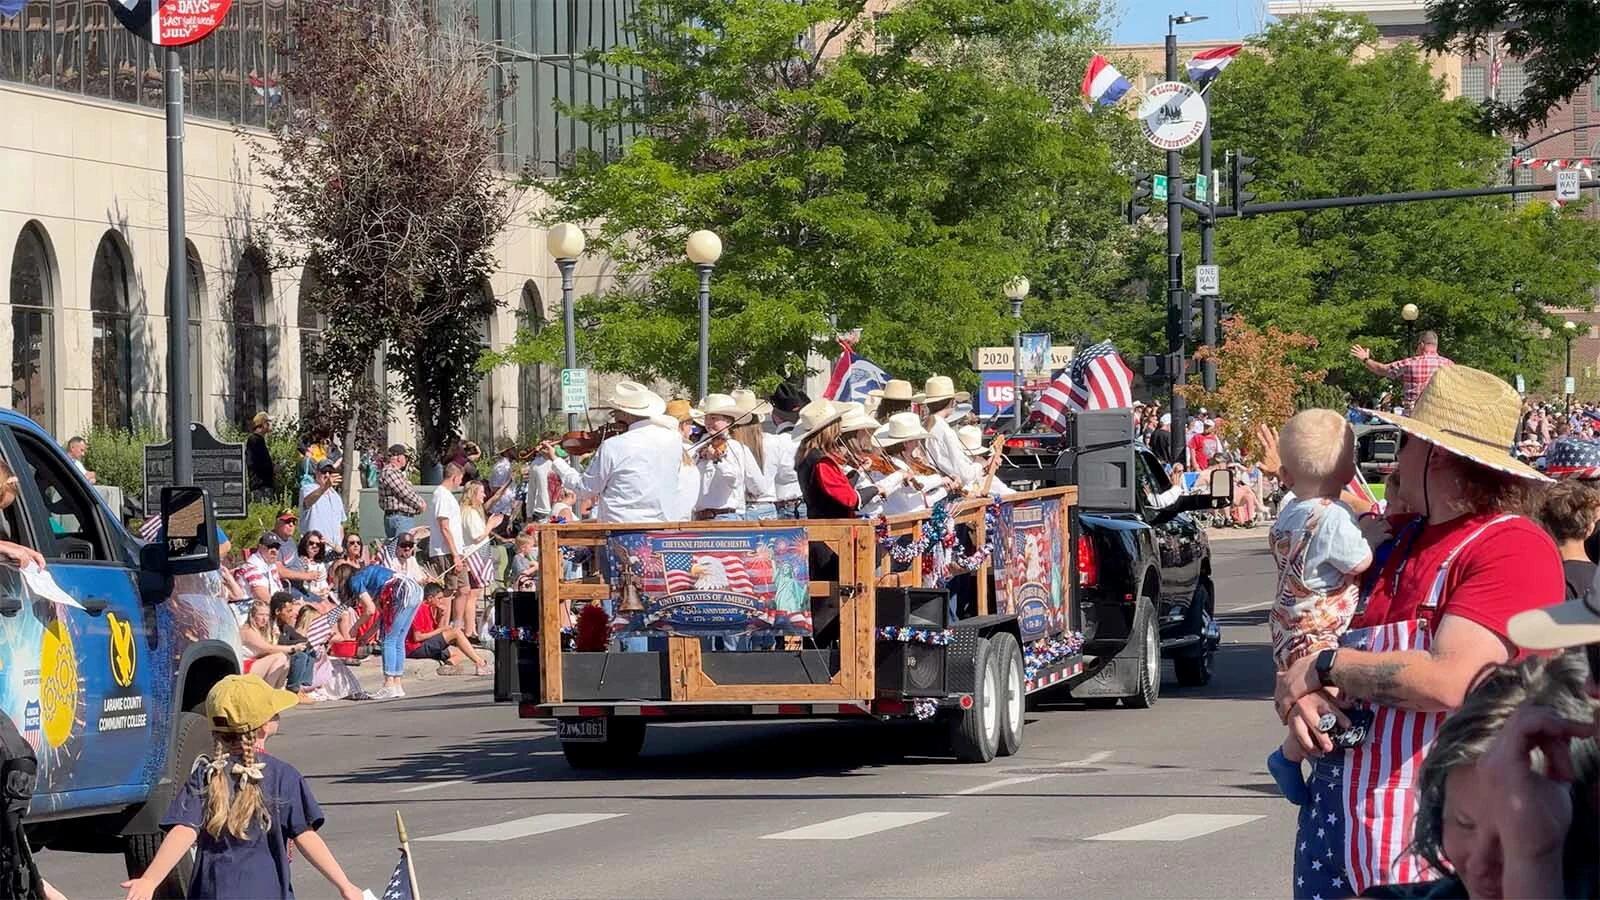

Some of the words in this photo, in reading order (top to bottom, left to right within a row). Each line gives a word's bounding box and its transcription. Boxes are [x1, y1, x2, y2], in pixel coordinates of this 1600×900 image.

[178, 0, 209, 14] DAYS
[162, 28, 191, 38] JULY
[1199, 267, 1216, 275] ONE
[1199, 275, 1216, 283] WAY
[983, 352, 1009, 365] 2020
[563, 372, 570, 385] 2
[661, 540, 693, 548] CHEYENNE
[694, 540, 715, 548] FIDDLE
[715, 539, 751, 548] ORCHESTRA
[659, 595, 686, 607] UNITED
[686, 593, 711, 602] STATES
[712, 593, 722, 601] OF
[723, 594, 754, 607] AMERICA
[702, 607, 738, 615] ANNIVERSARY
[104, 697, 124, 712] LARAMIE
[123, 695, 143, 710] COUNTY
[98, 714, 127, 732] COMMUNITY
[126, 713, 147, 729] COLLEGE
